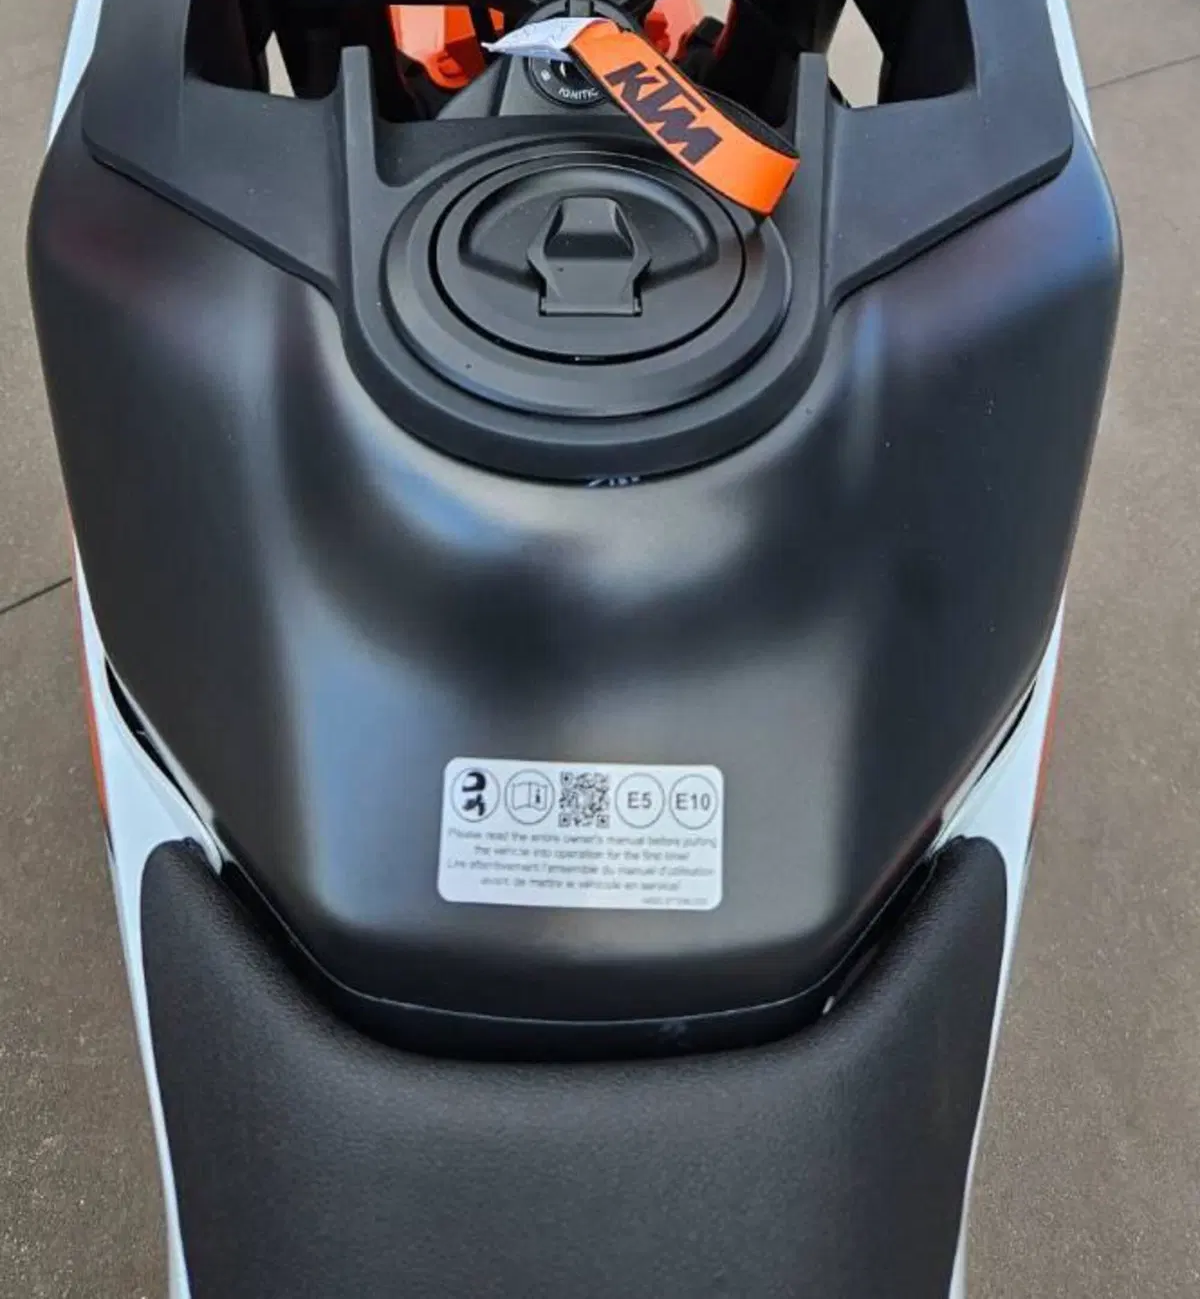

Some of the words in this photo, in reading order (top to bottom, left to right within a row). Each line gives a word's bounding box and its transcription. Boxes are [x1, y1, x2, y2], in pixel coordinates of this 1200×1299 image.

[603, 61, 724, 166] KTM
[627, 791, 652, 810] E5
[676, 793, 711, 812] E10
